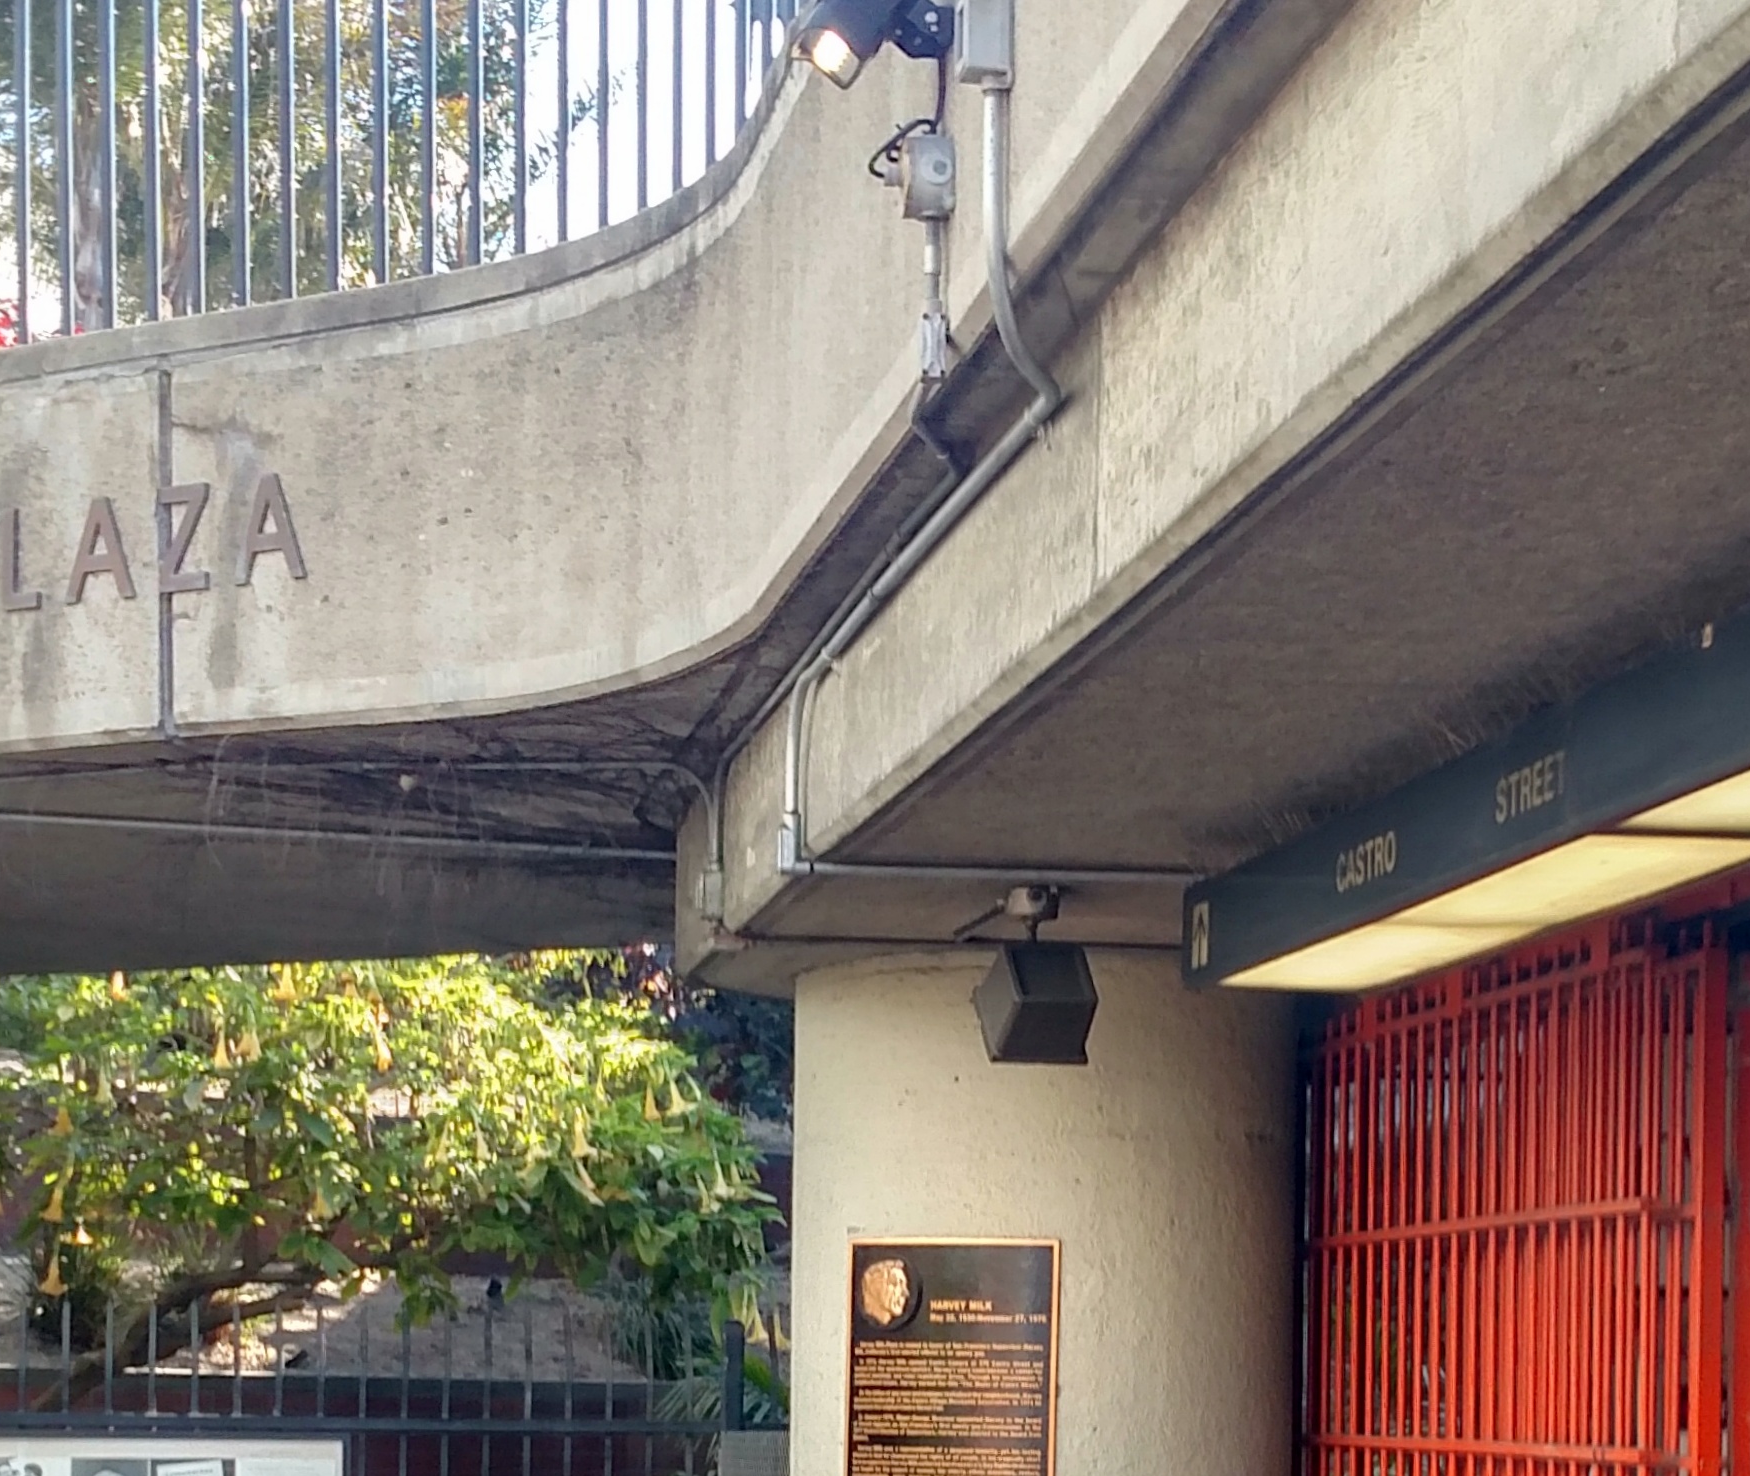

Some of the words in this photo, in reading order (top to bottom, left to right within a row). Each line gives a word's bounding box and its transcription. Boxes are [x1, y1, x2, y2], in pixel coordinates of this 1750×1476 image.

[1335, 830, 1397, 893] CASTRO
[1494, 750, 1566, 824] STREET
[930, 1299, 966, 1311] HARVEY
[968, 1299, 993, 1312] MILK
